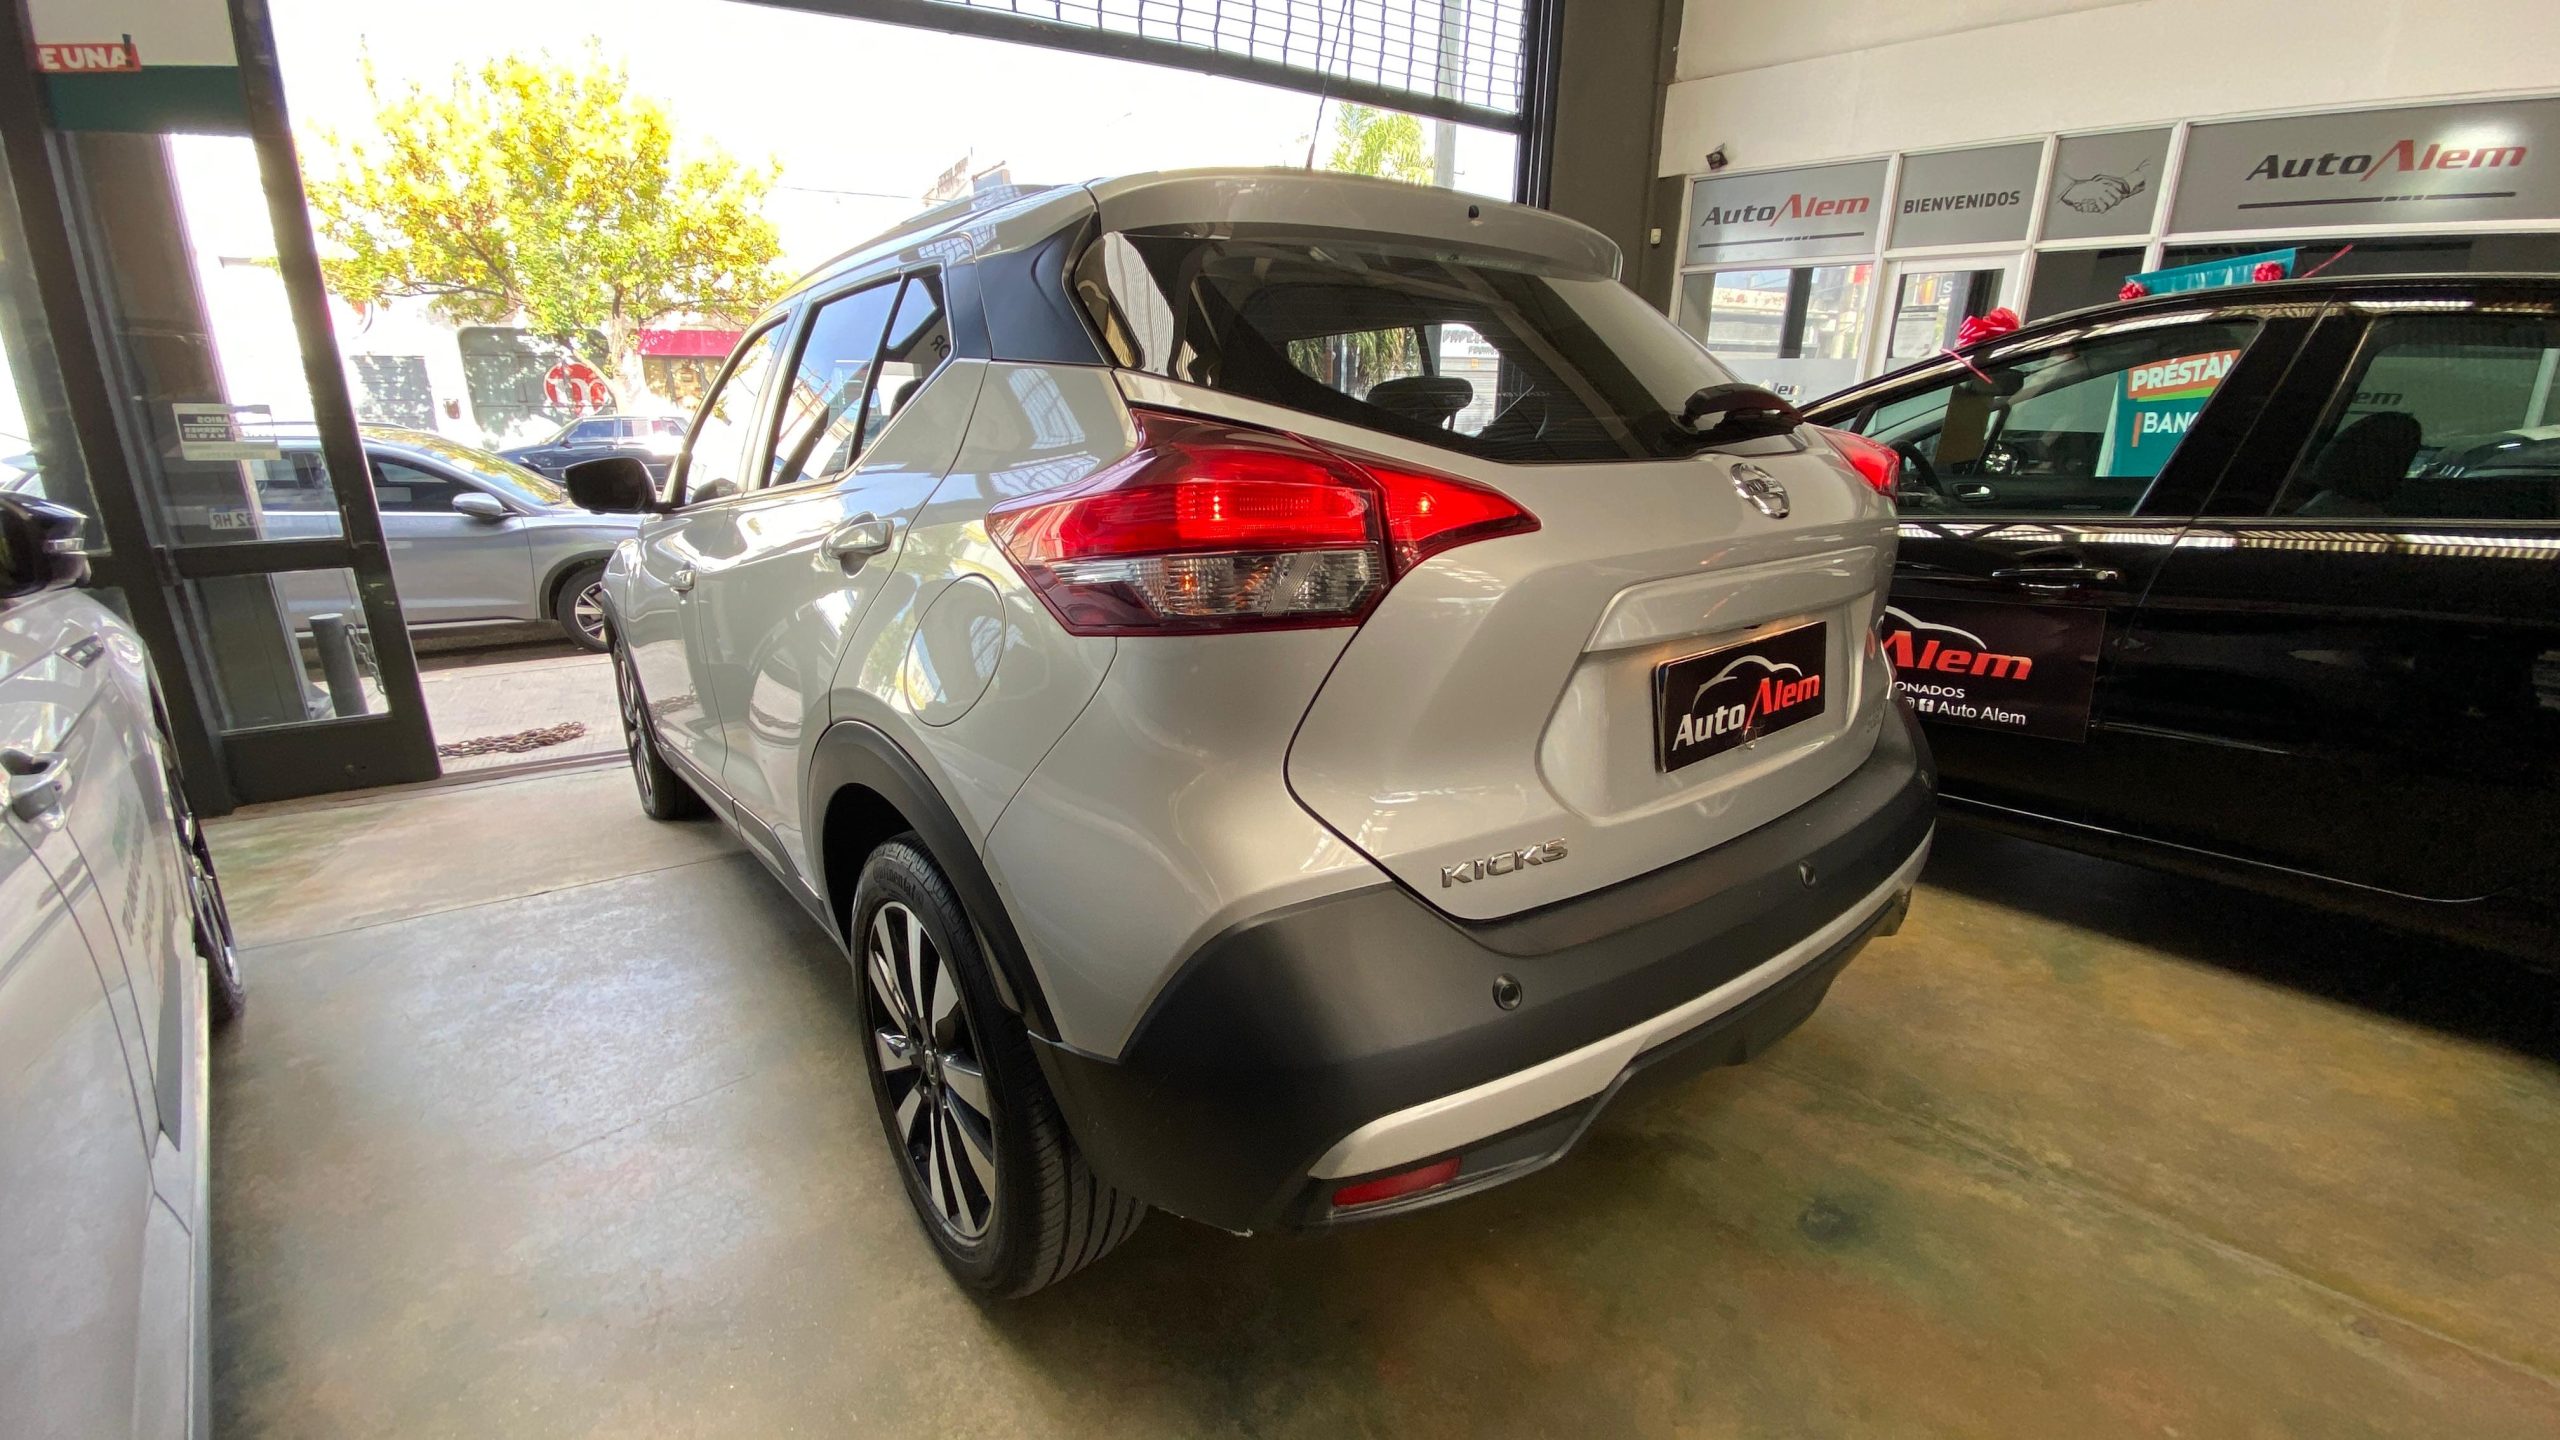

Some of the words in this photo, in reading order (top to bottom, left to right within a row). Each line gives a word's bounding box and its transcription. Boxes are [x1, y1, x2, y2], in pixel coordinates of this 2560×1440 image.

[39, 47, 60, 69] E
[1903, 190, 2021, 214] BIENVENIDOS
[1895, 681, 1966, 699] ONADOS
[1937, 701, 1977, 719] Auto
[1980, 706, 2026, 726] Alem
[1440, 837, 1569, 888] KICKS
